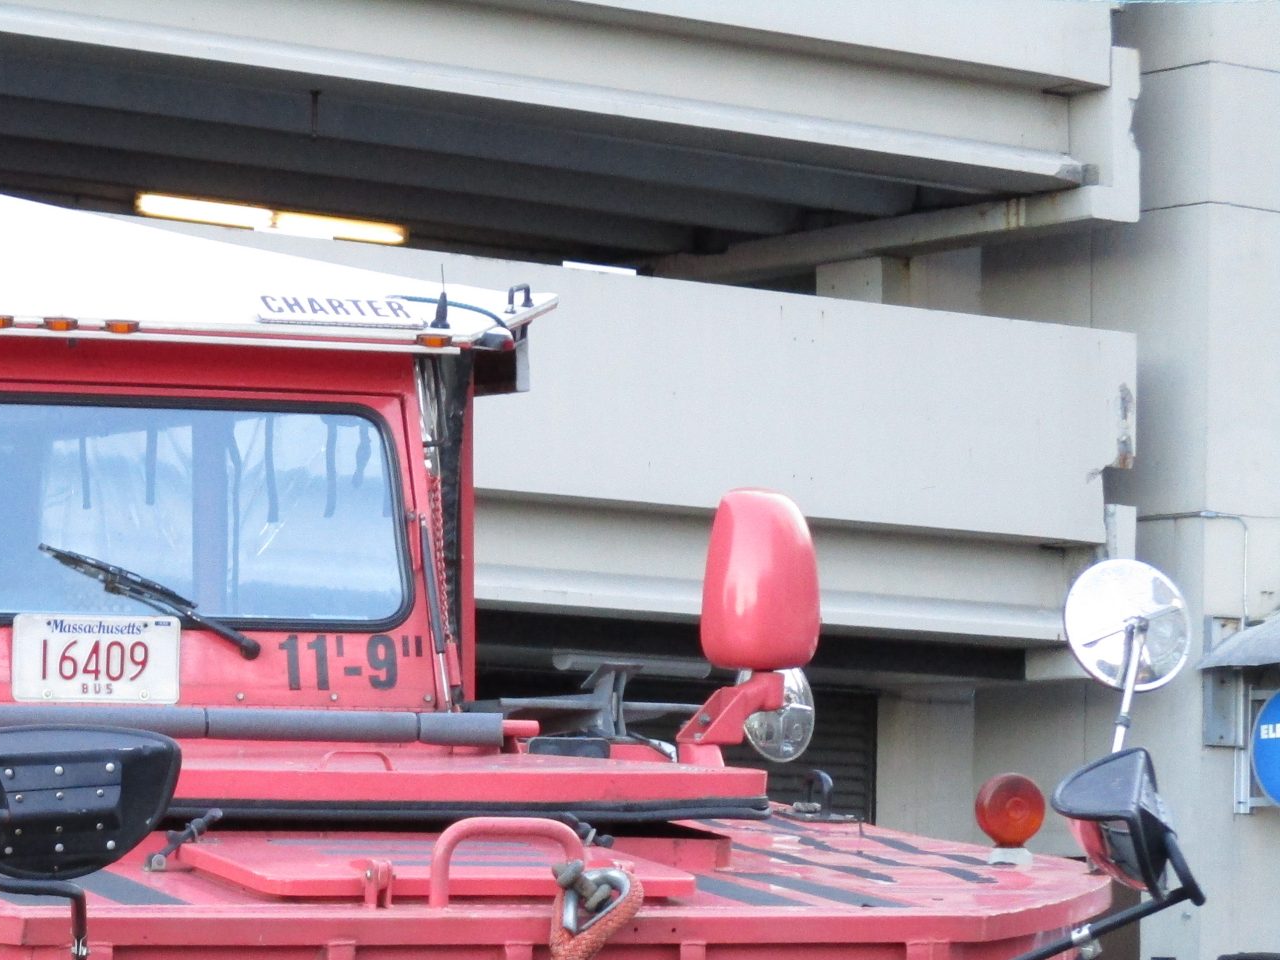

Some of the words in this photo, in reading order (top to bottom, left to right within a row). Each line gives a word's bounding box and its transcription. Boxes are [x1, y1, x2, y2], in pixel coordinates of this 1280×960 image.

[260, 294, 412, 319] CHARTER
[51, 619, 142, 636] Massachusetts
[41, 639, 149, 682] 16409
[278, 634, 423, 691] 11'-9"
[81, 683, 114, 695] BUS
